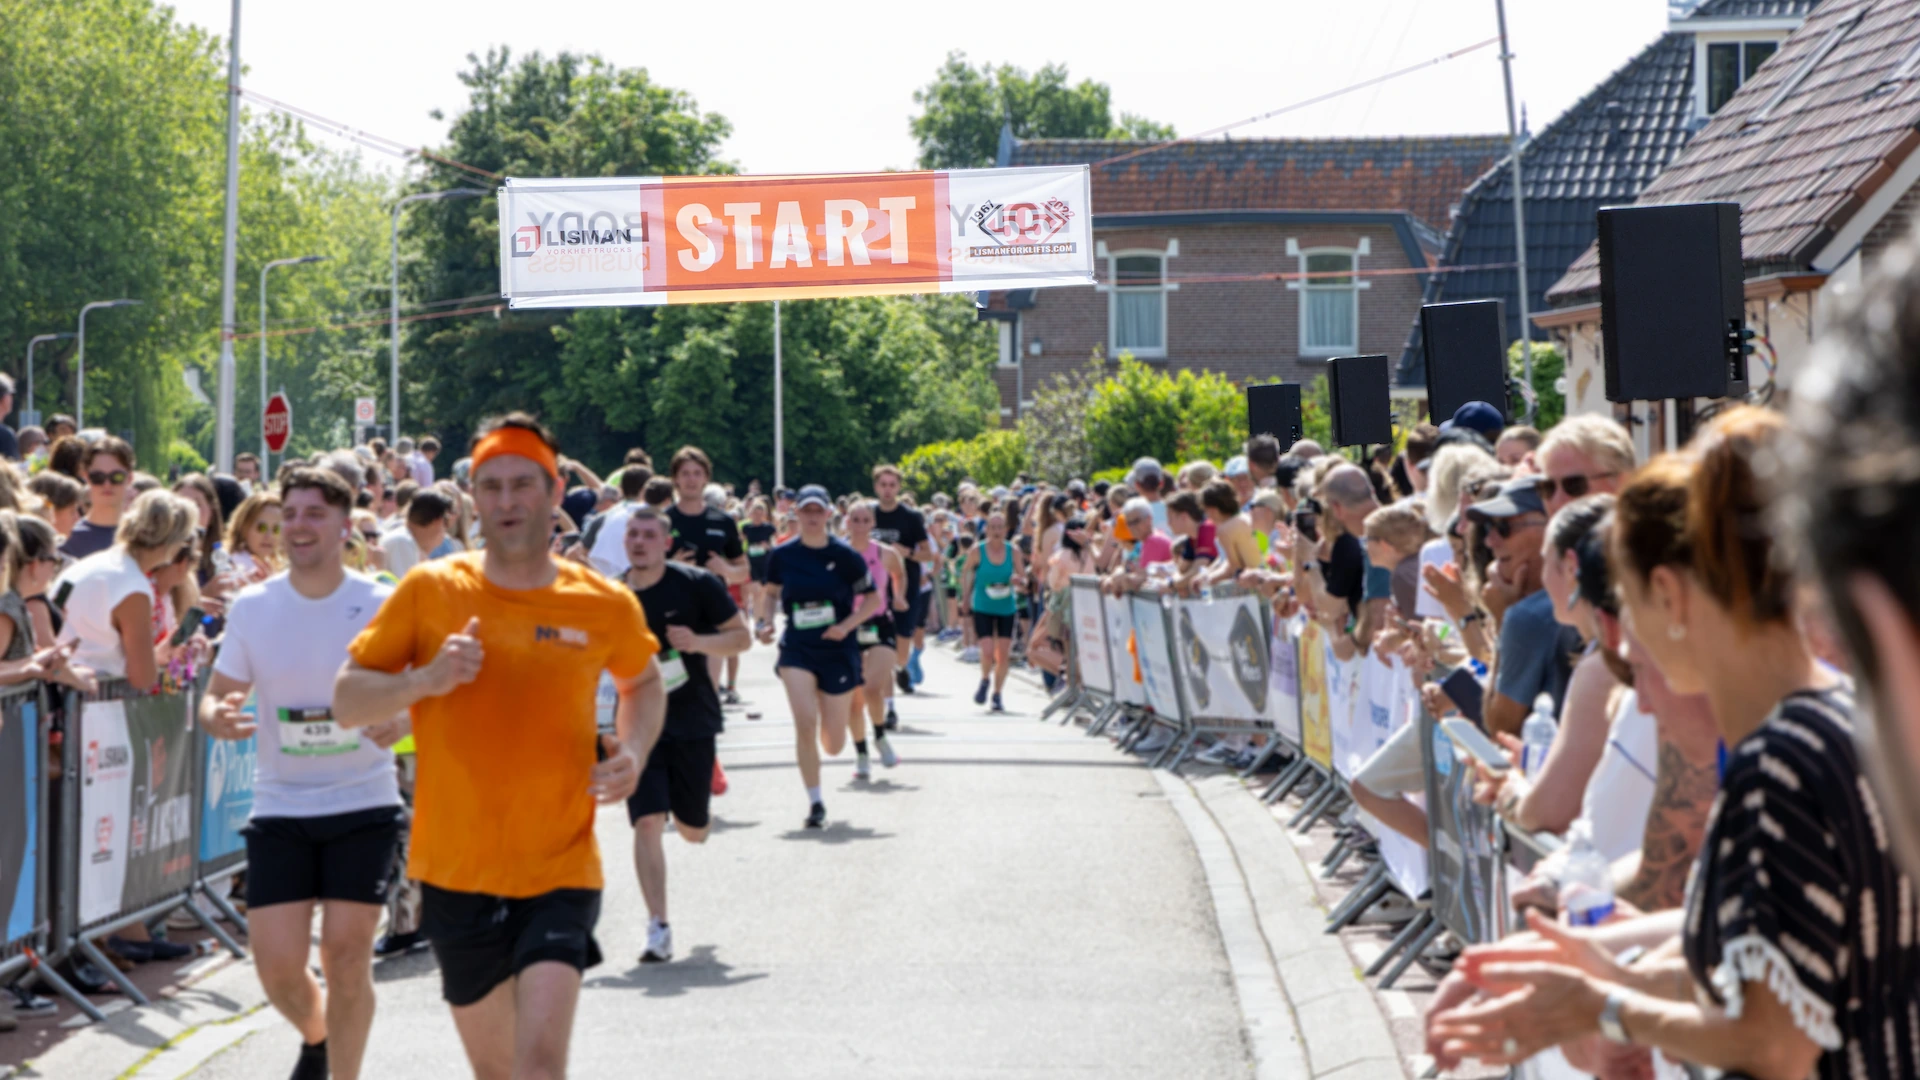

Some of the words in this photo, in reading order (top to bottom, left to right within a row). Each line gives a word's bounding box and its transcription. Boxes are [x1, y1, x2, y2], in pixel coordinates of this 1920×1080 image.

[969, 198, 996, 225] 1967
[546, 227, 632, 247] LISMAN
[676, 196, 916, 272] START
[547, 246, 632, 256] VORKHEFTRUCKS
[974, 244, 1073, 257] LISMANFORKLIFTS.COM
[264, 412, 288, 435] STOP
